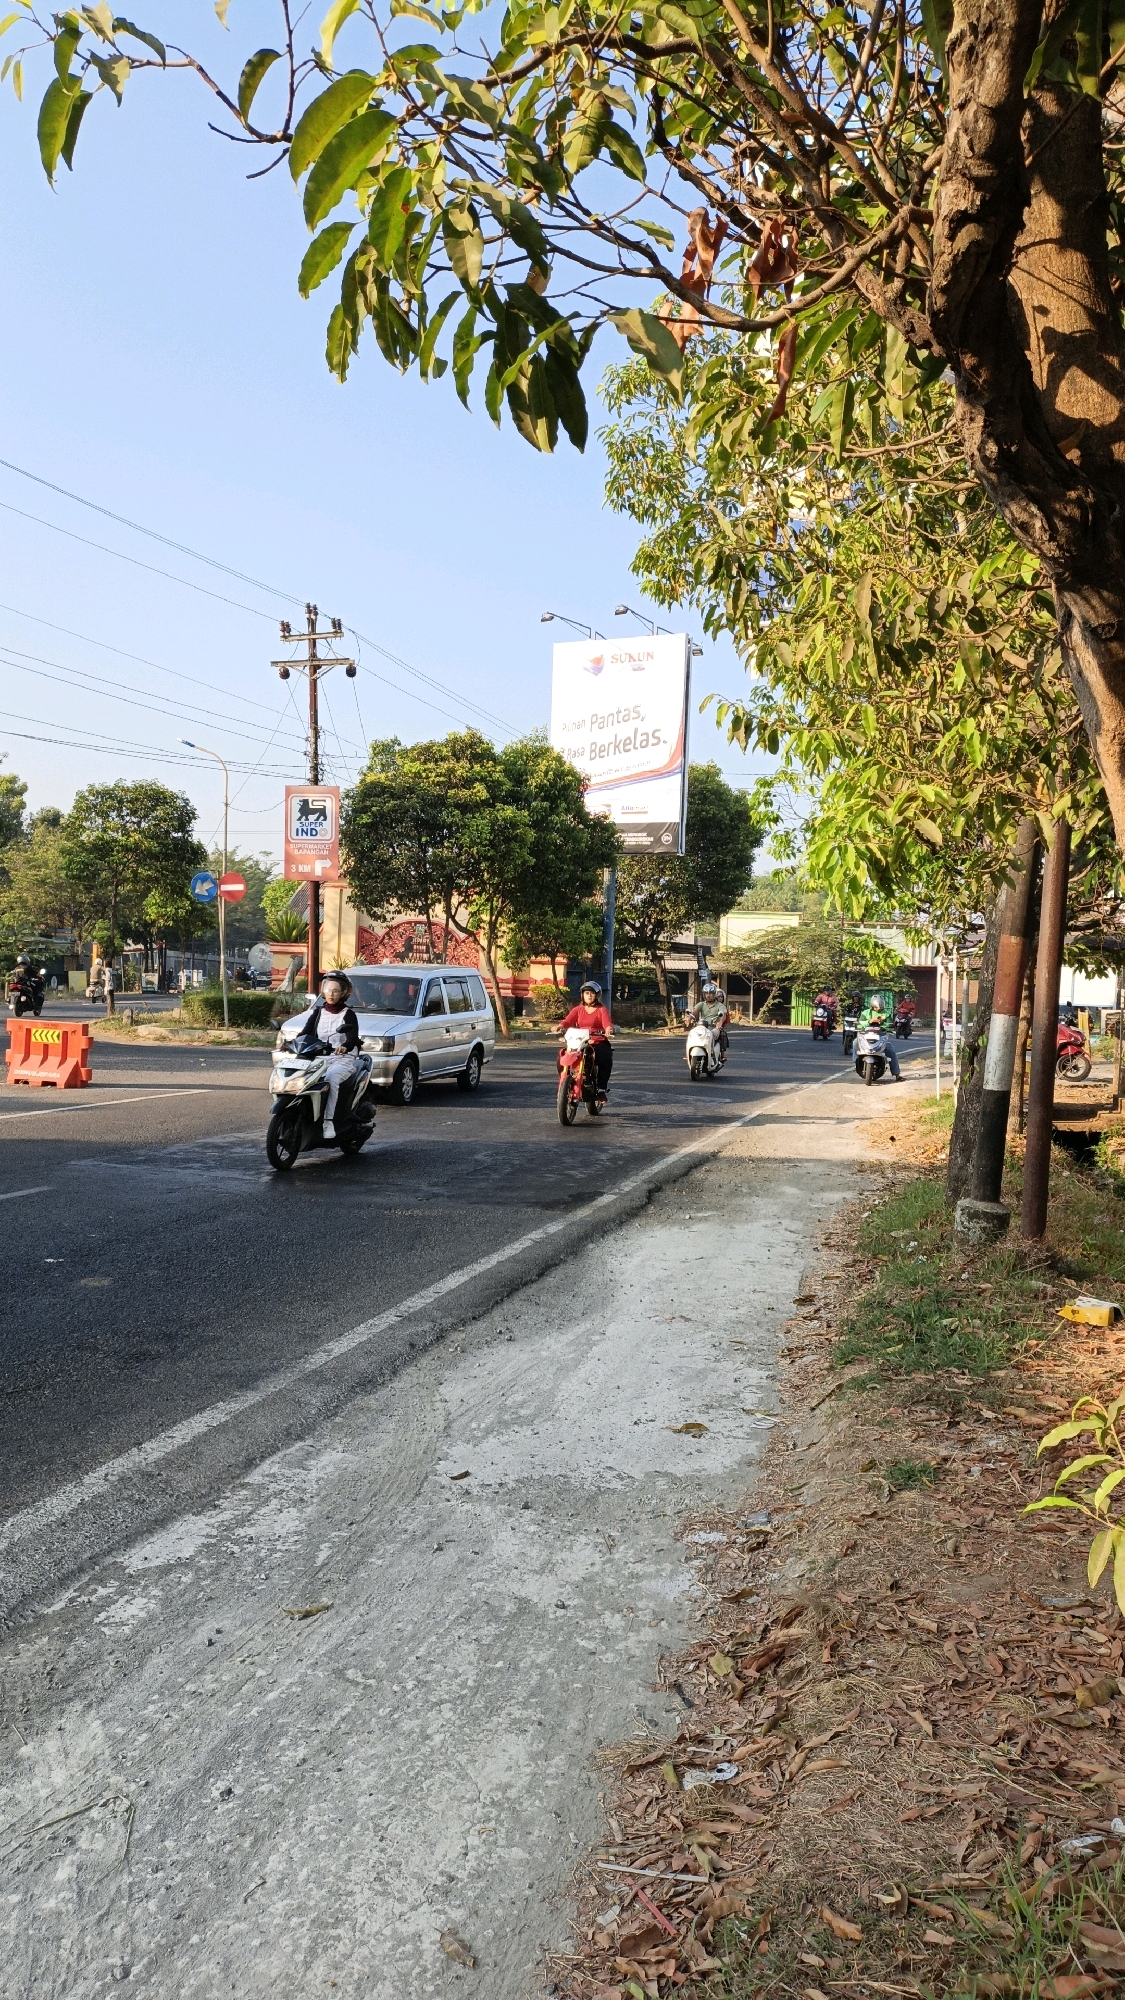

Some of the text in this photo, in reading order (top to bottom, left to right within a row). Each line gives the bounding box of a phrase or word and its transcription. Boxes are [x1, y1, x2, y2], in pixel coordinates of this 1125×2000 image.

[611, 651, 654, 664] SUKUN
[589, 704, 646, 732] Pantas,
[566, 727, 668, 761] Rasa Berkelas.
[295, 827, 328, 837] INDO
[290, 864, 311, 873] 3 KM
